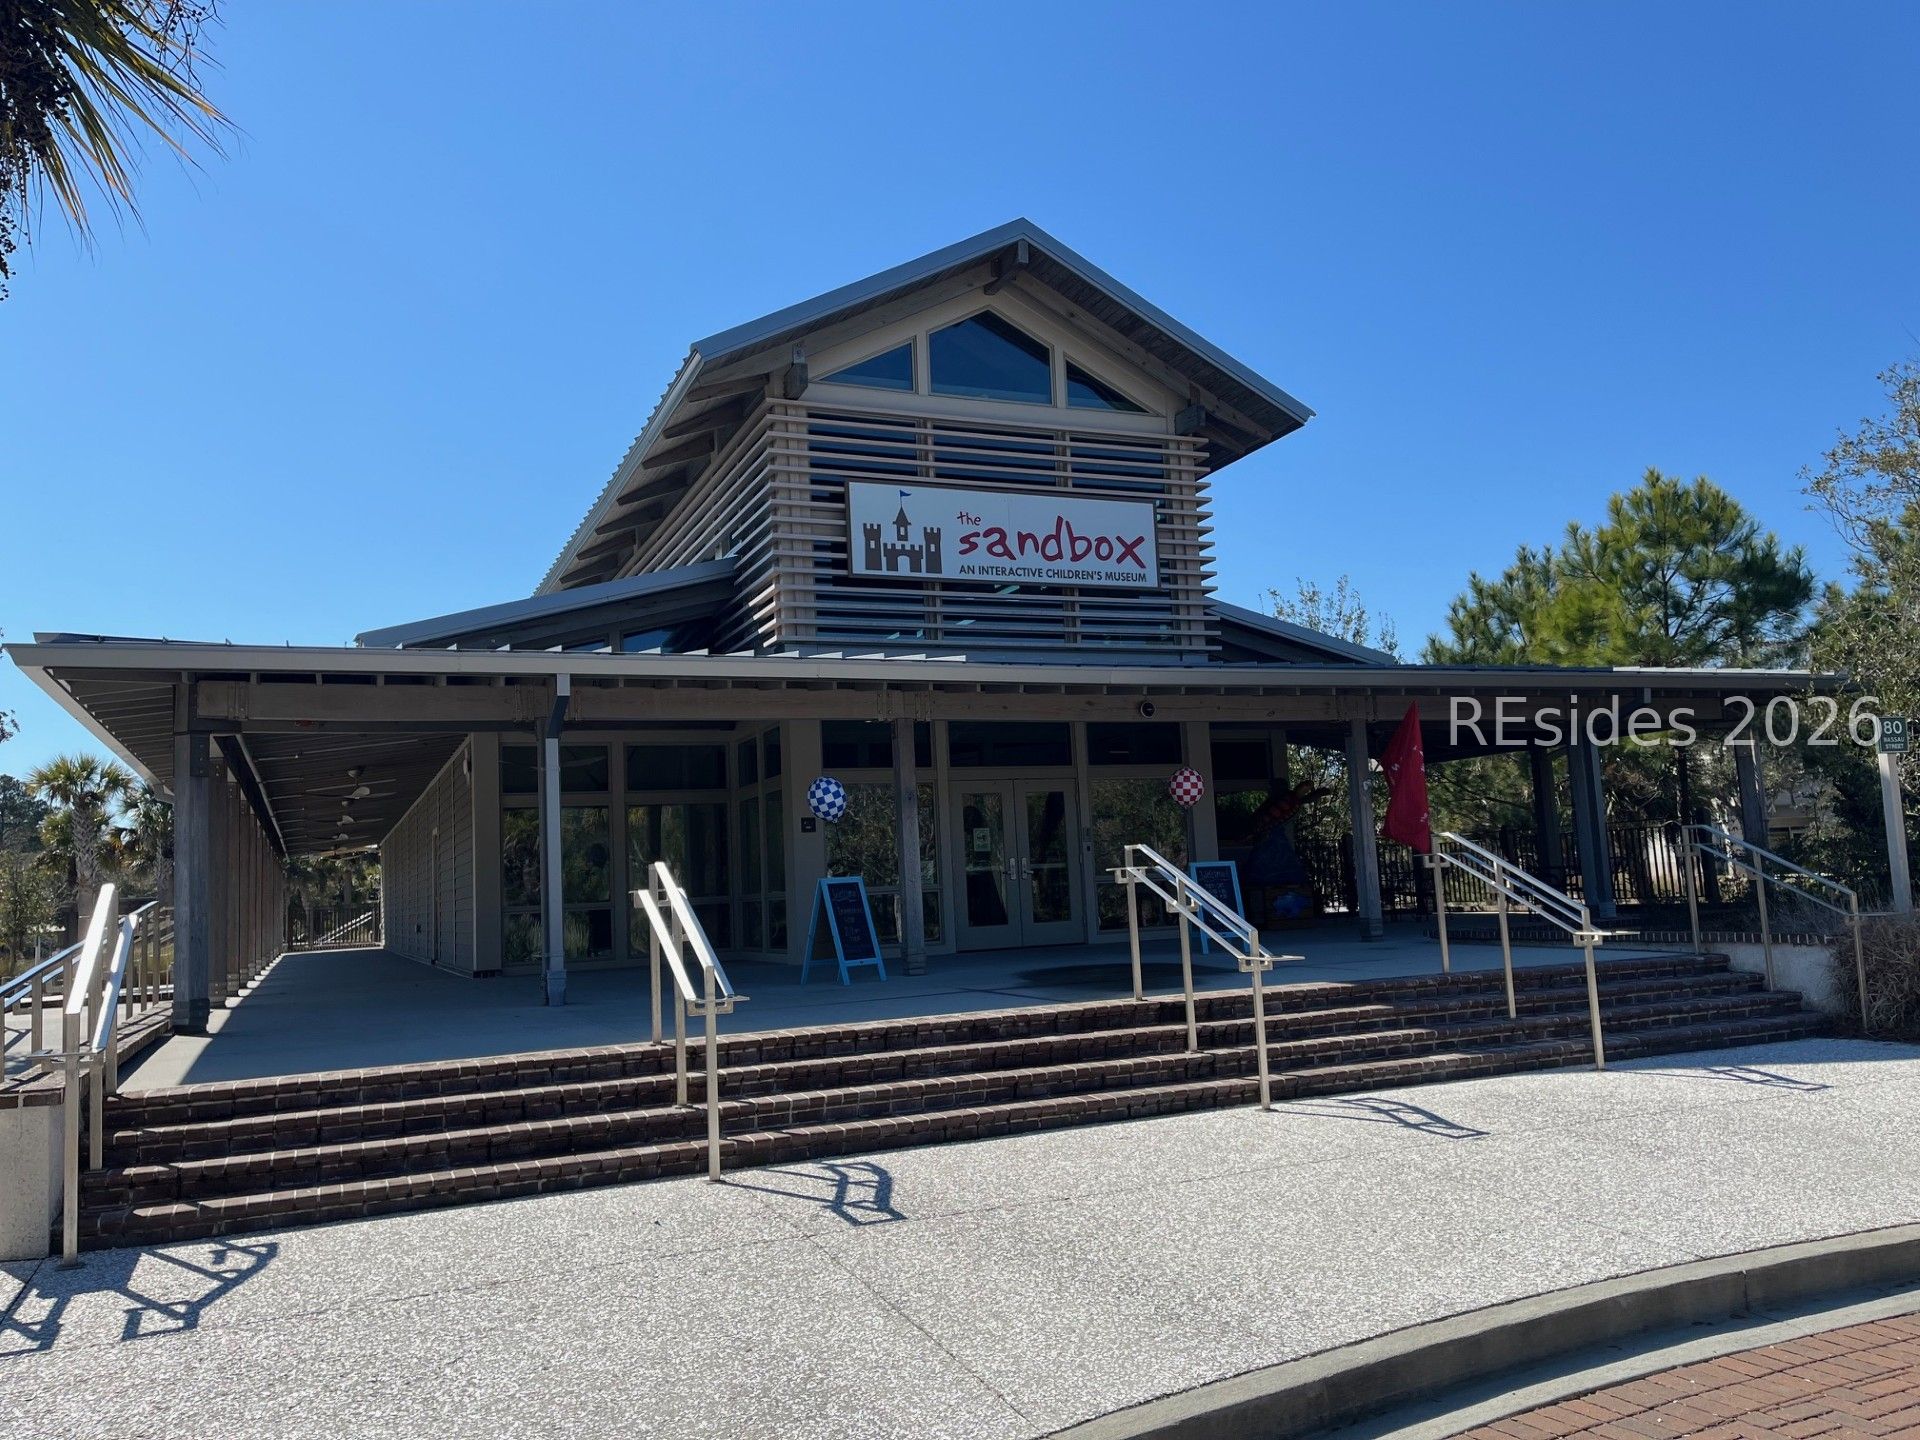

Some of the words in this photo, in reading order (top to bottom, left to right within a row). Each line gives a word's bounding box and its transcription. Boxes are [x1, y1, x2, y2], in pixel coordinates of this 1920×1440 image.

[957, 511, 981, 526] the
[958, 515, 1147, 569] sandbox
[959, 565, 975, 575] AN
[978, 566, 1045, 578] INTERACTIVE
[1047, 568, 1103, 581] CHILDREN'S
[1105, 571, 1147, 583] MUSEUM
[1883, 721, 1902, 735] 80
